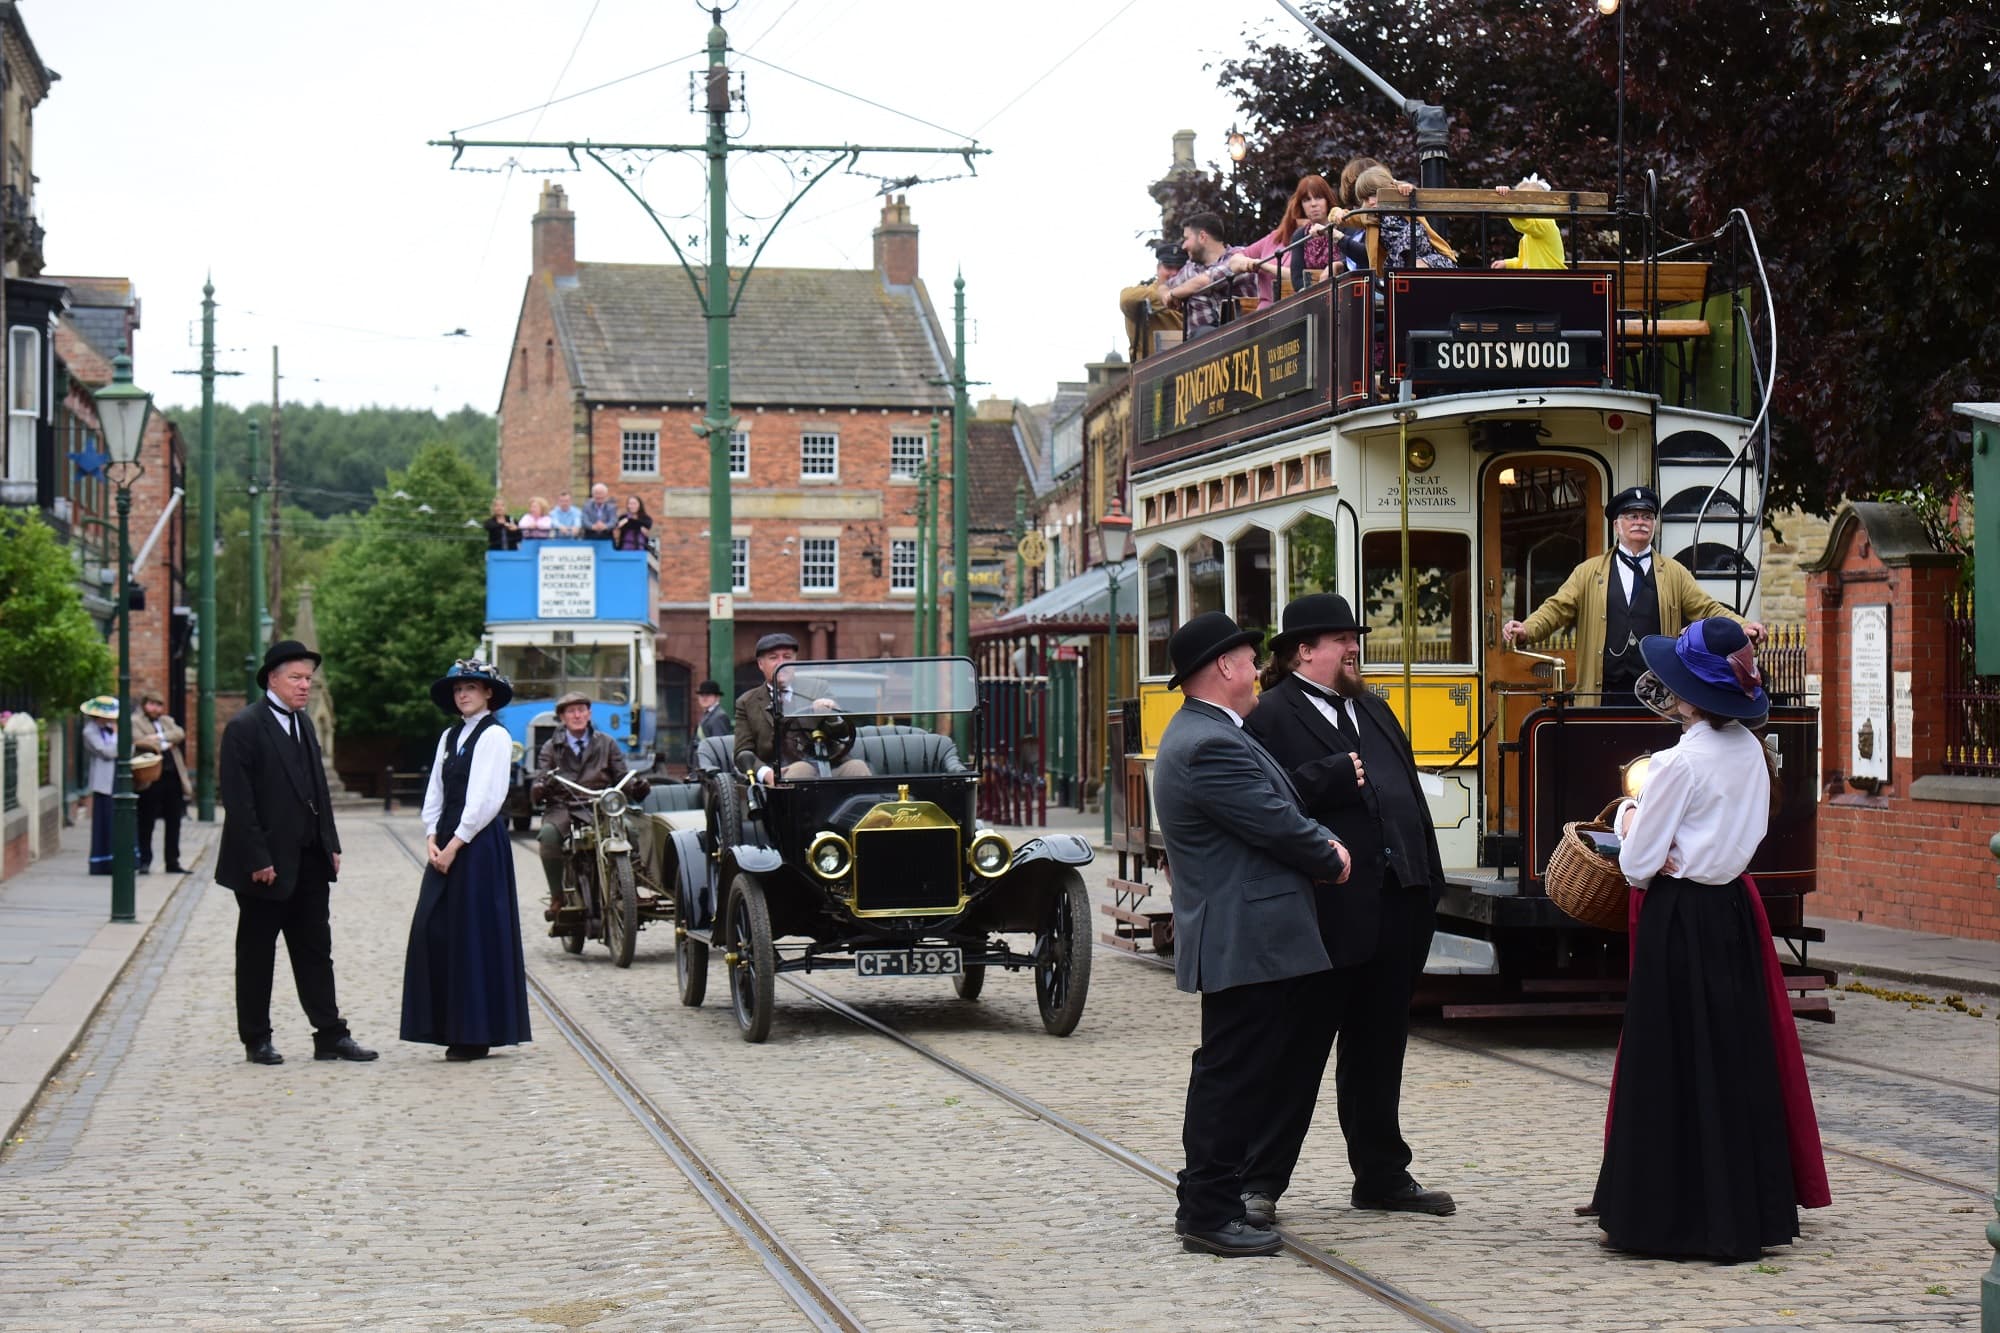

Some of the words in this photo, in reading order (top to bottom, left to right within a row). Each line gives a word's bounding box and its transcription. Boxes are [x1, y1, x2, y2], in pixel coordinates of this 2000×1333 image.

[1437, 341, 1570, 369] SCOTSWOOD
[1174, 355, 1231, 427] RINGTONS
[1232, 344, 1263, 401] TEA
[1414, 475, 1441, 485] SEAT
[1387, 487, 1400, 496] 29
[1407, 486, 1448, 496] PSTAIRS
[1378, 497, 1389, 506] 24
[1394, 497, 1456, 506] DWNSTAIRS
[716, 595, 727, 616] F
[892, 807, 922, 824] Ford
